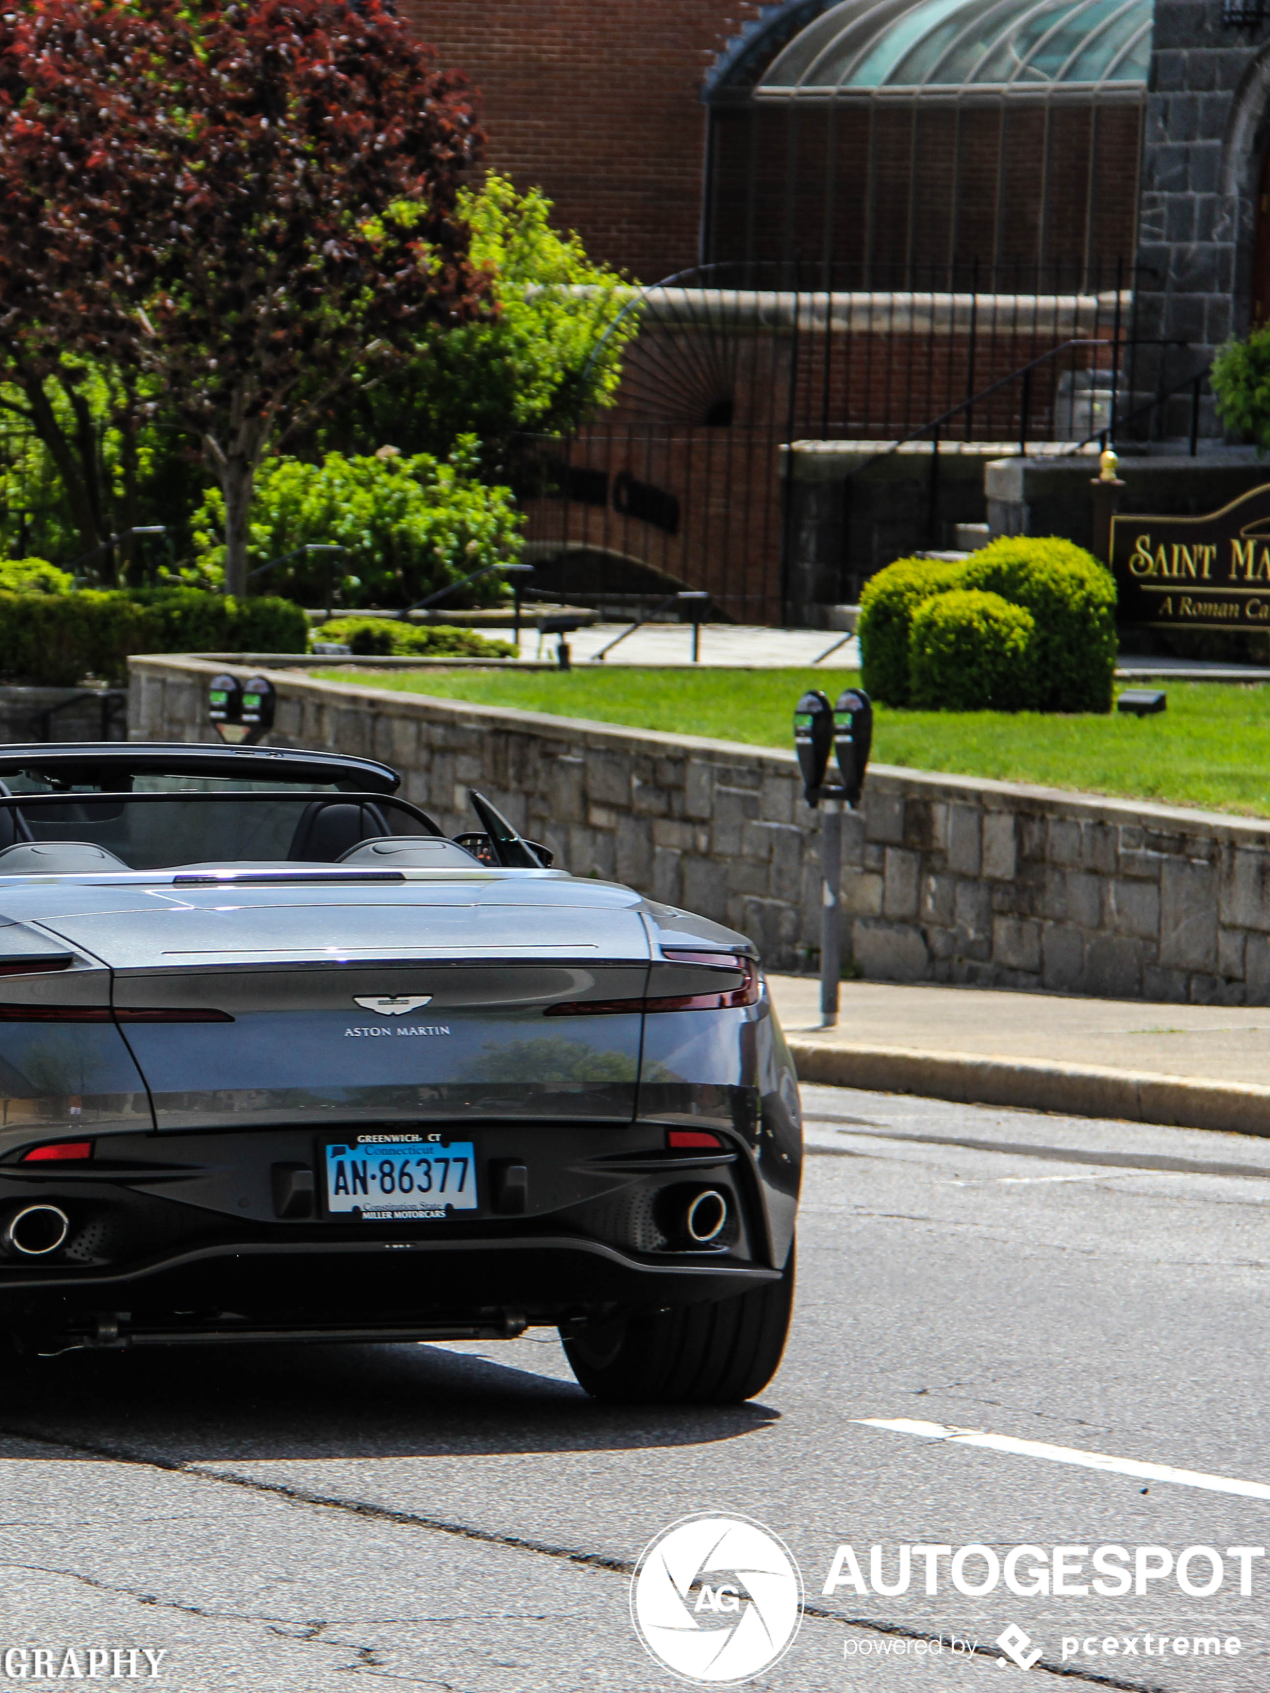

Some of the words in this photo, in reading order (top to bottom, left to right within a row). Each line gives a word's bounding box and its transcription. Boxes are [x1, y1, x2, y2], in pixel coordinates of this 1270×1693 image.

[1130, 534, 1217, 580] SAINT
[1229, 538, 1270, 581] MA
[1159, 596, 1173, 616] A
[1180, 596, 1239, 618] Roman
[344, 1026, 392, 1037] ASTON
[396, 1026, 450, 1036] MARTIN
[427, 1133, 442, 1142] CT
[364, 1145, 435, 1156] Connecticut
[363, 1202, 419, 1212] Constitution
[420, 1201, 443, 1211] State
[362, 1211, 393, 1220] MILLER
[393, 1210, 446, 1219] MOTORCARS
